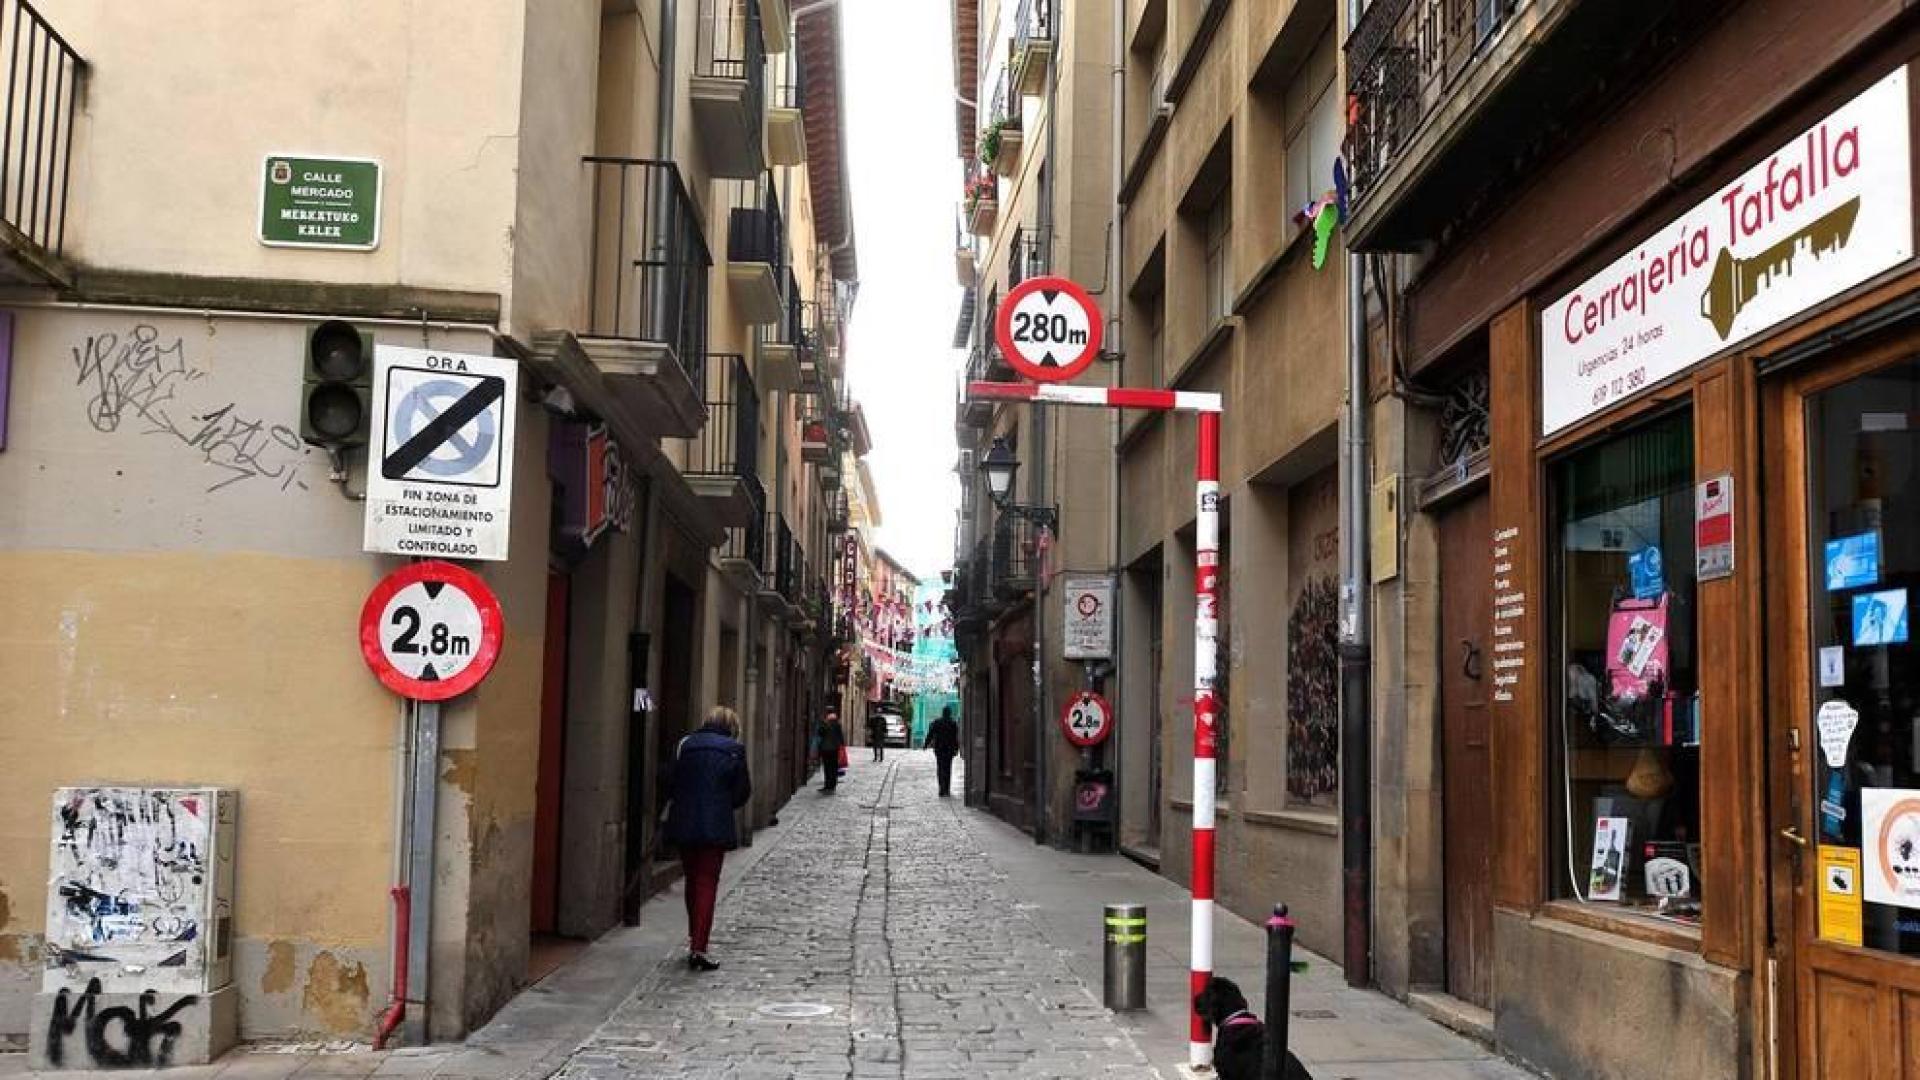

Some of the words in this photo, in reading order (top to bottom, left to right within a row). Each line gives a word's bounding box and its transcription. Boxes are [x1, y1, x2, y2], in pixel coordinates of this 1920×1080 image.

[303, 171, 342, 183] CALLE
[290, 186, 353, 199] MERCADO
[280, 208, 359, 223] MERKATUKO
[297, 225, 342, 238] KALEA
[1563, 225, 1710, 345] Cerrajería
[1721, 124, 1860, 246] Tafalla
[1578, 348, 1618, 377] Urgencias
[1621, 335, 1634, 355] 24
[1637, 324, 1663, 347] horas
[402, 489, 423, 500] FIN
[426, 491, 460, 504] ZONA
[464, 494, 478, 505] DE
[385, 505, 494, 522] ESTACIONAMIENTO
[408, 523, 462, 537] LIMITADO
[466, 527, 474, 538] Y
[397, 540, 478, 555] CONTROLADO
[391, 604, 470, 657] 2,8m
